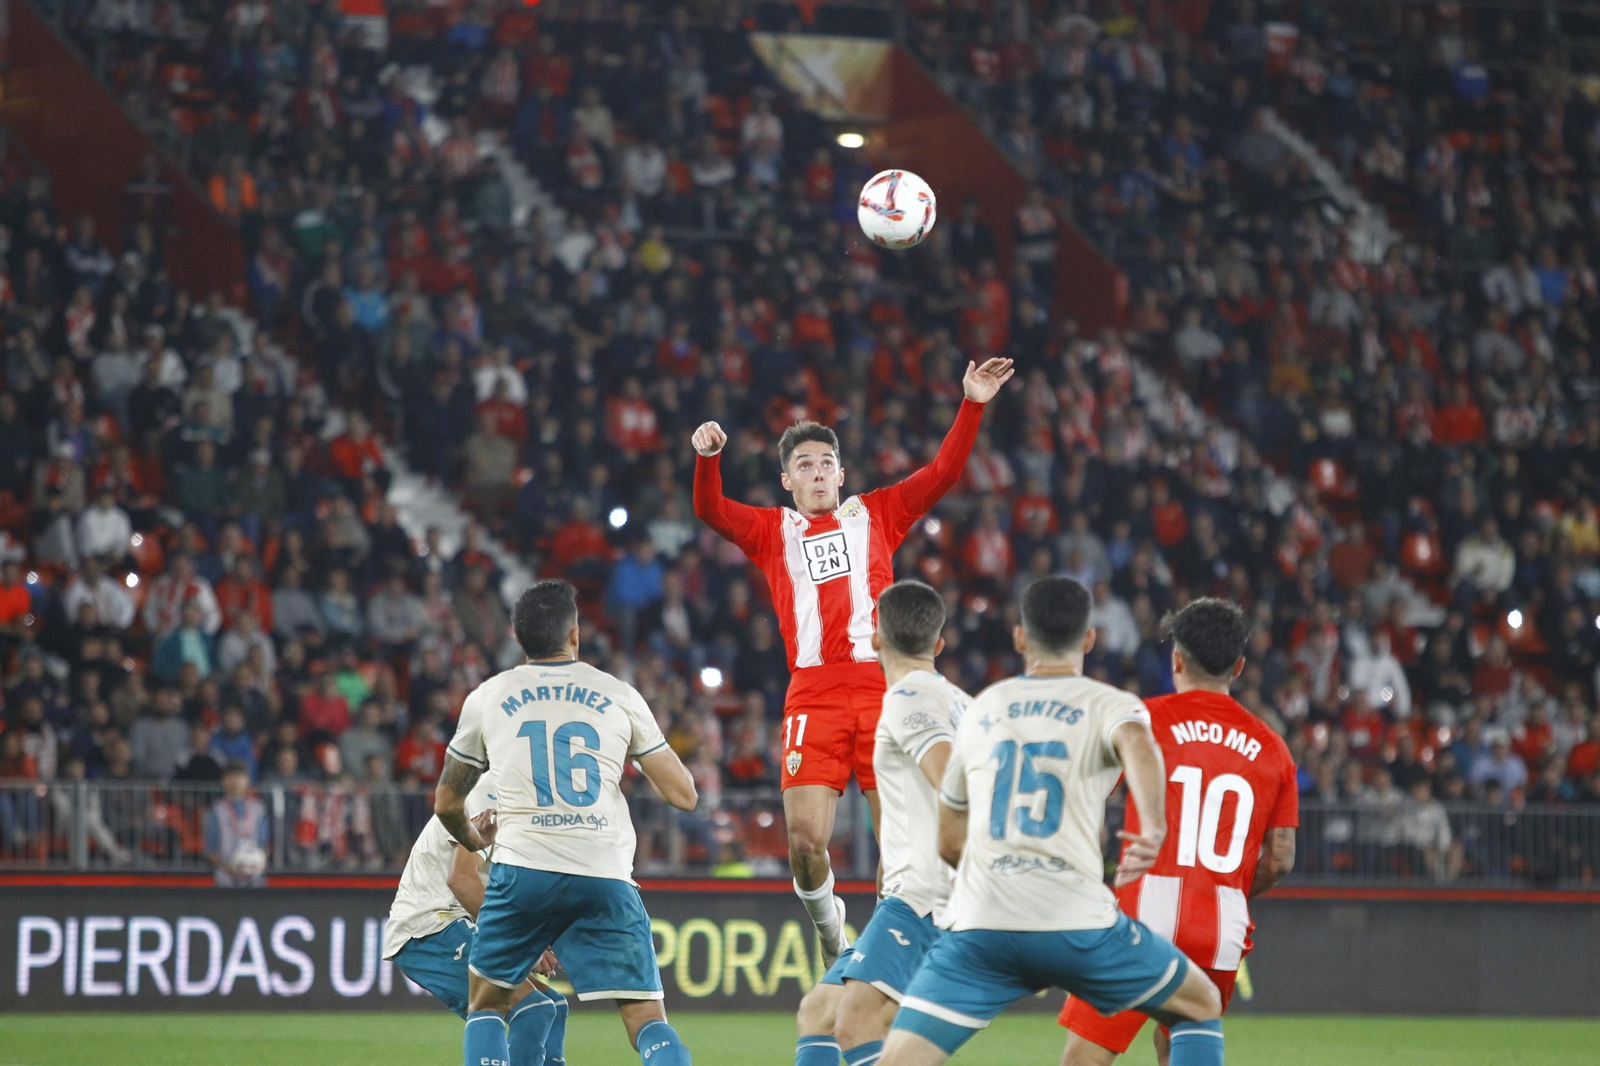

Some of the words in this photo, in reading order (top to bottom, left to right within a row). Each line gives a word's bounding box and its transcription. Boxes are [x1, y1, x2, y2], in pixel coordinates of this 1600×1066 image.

[814, 542, 838, 558] DA
[818, 556, 841, 573] ZN
[500, 683, 613, 717] MARTÍNEZ
[1008, 701, 1084, 726] SINTES
[1170, 720, 1224, 745] NICO
[1223, 728, 1262, 761] MR
[516, 720, 601, 807] 16
[988, 740, 1069, 840] 15
[1169, 765, 1254, 873] 10
[16, 915, 316, 996] PIERDAS
